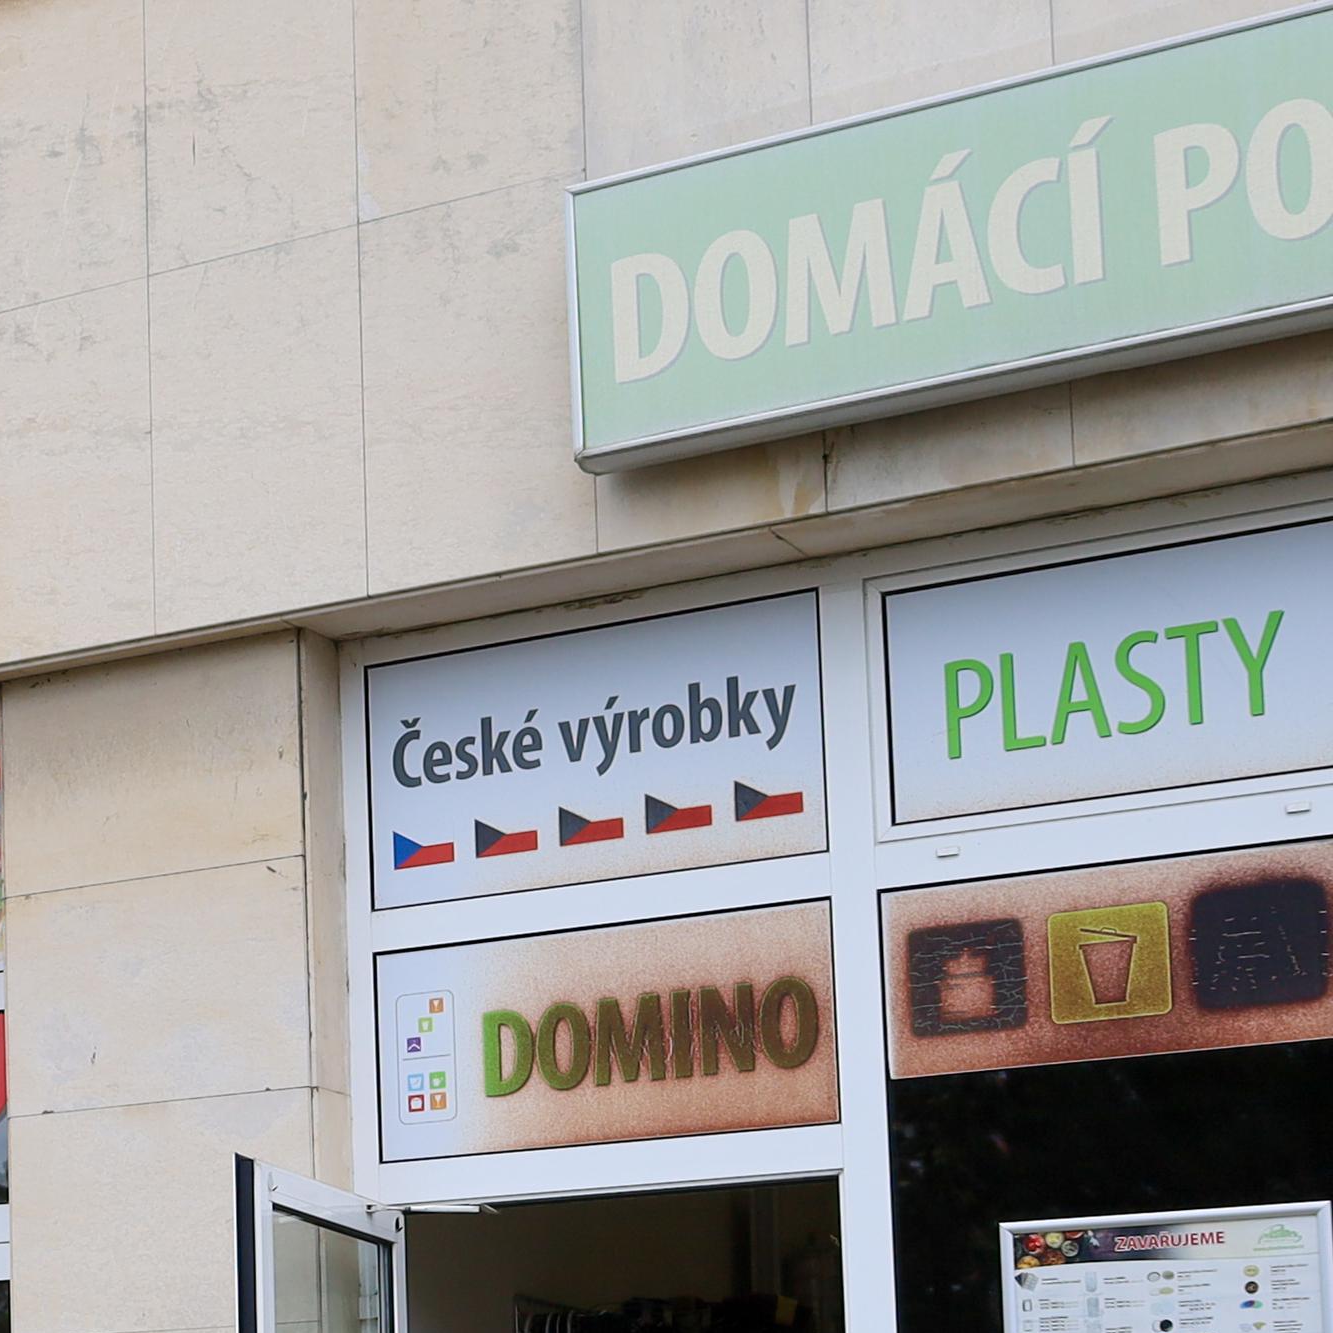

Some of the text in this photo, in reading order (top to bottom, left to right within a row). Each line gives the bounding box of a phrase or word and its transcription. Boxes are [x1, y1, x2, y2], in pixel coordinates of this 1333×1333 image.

[610, 114, 1115, 385] DOMÁCÍ
[393, 674, 797, 789] České výrobky
[942, 609, 1285, 759] PLASTY
[481, 975, 819, 1100] DOMINO
[1114, 1231, 1226, 1252] ZAVAŘUJEME
